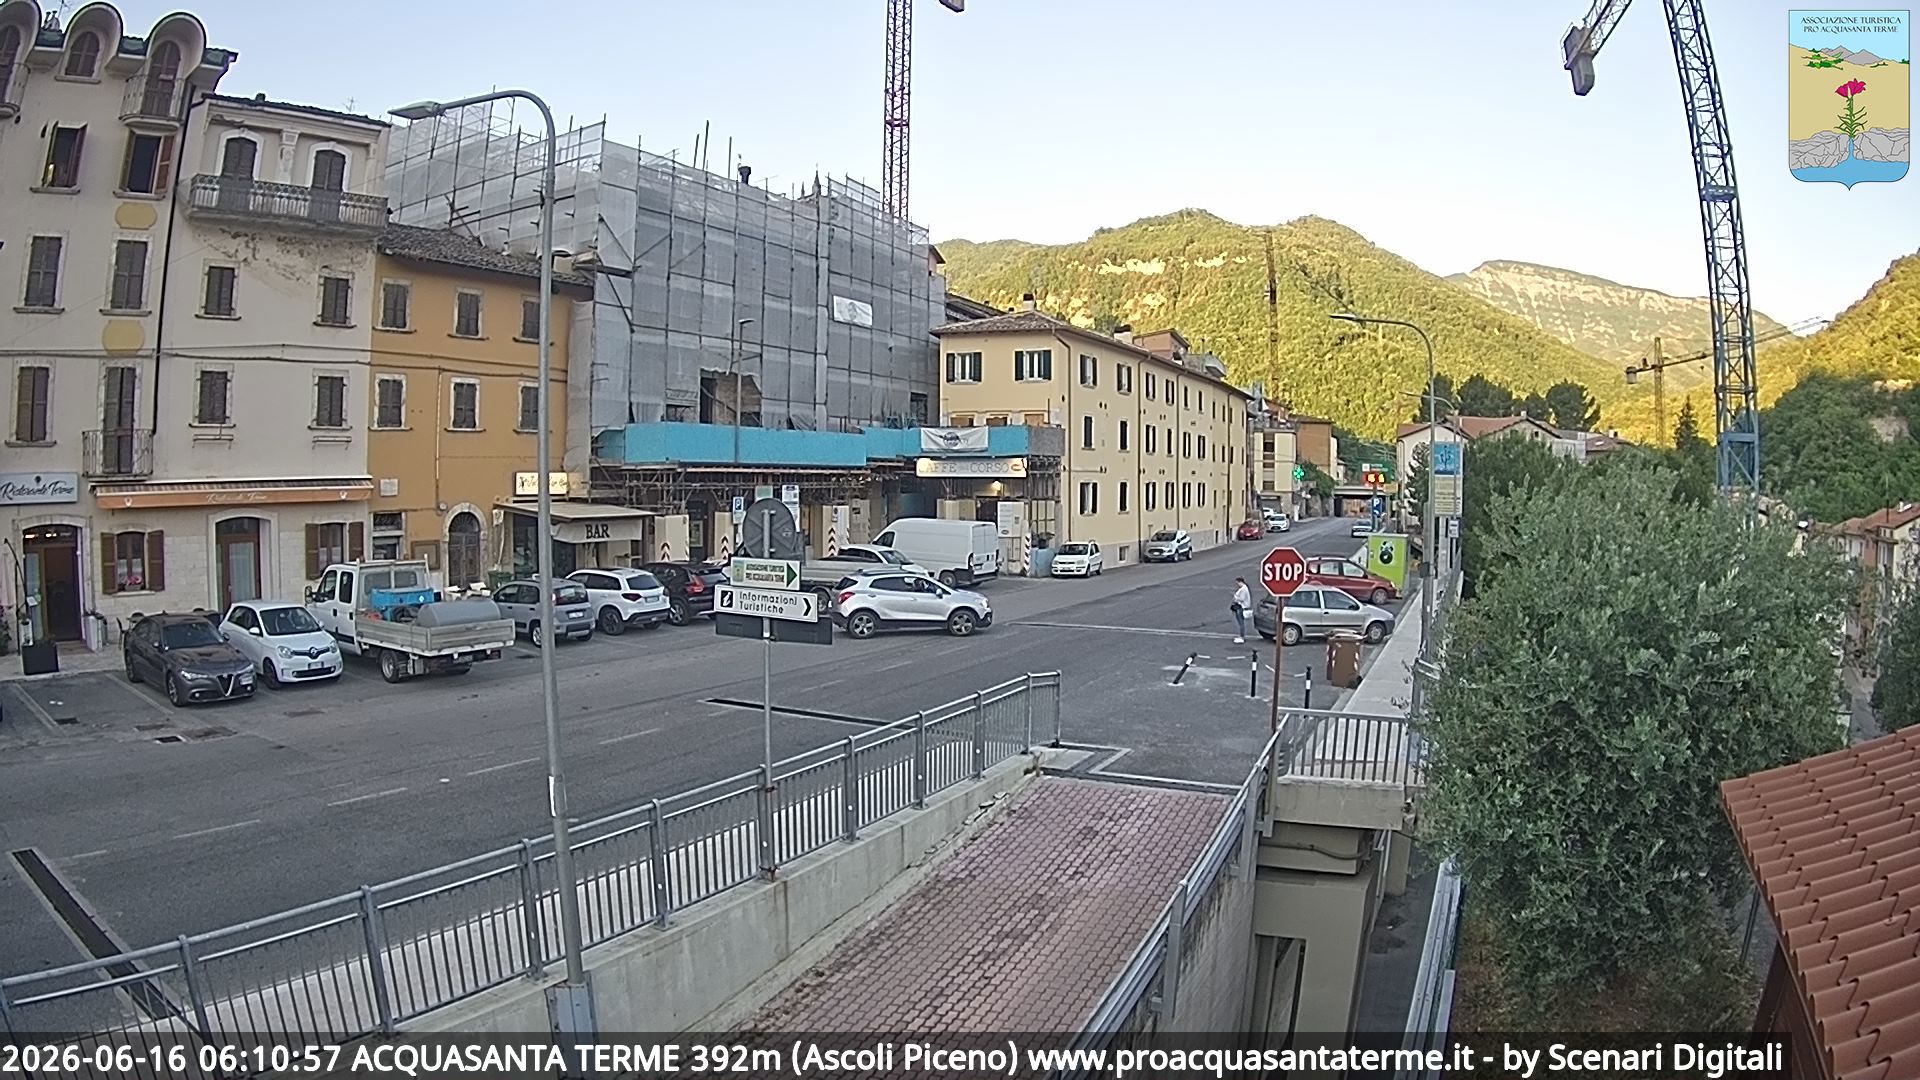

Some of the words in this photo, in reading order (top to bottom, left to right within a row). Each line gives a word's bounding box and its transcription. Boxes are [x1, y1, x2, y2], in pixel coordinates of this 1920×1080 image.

[969, 463, 1009, 473] CORSO
[585, 524, 610, 539] BAR
[1264, 563, 1303, 581] STOP
[739, 592, 797, 606] Informazioni
[739, 601, 784, 614] Turistiche
